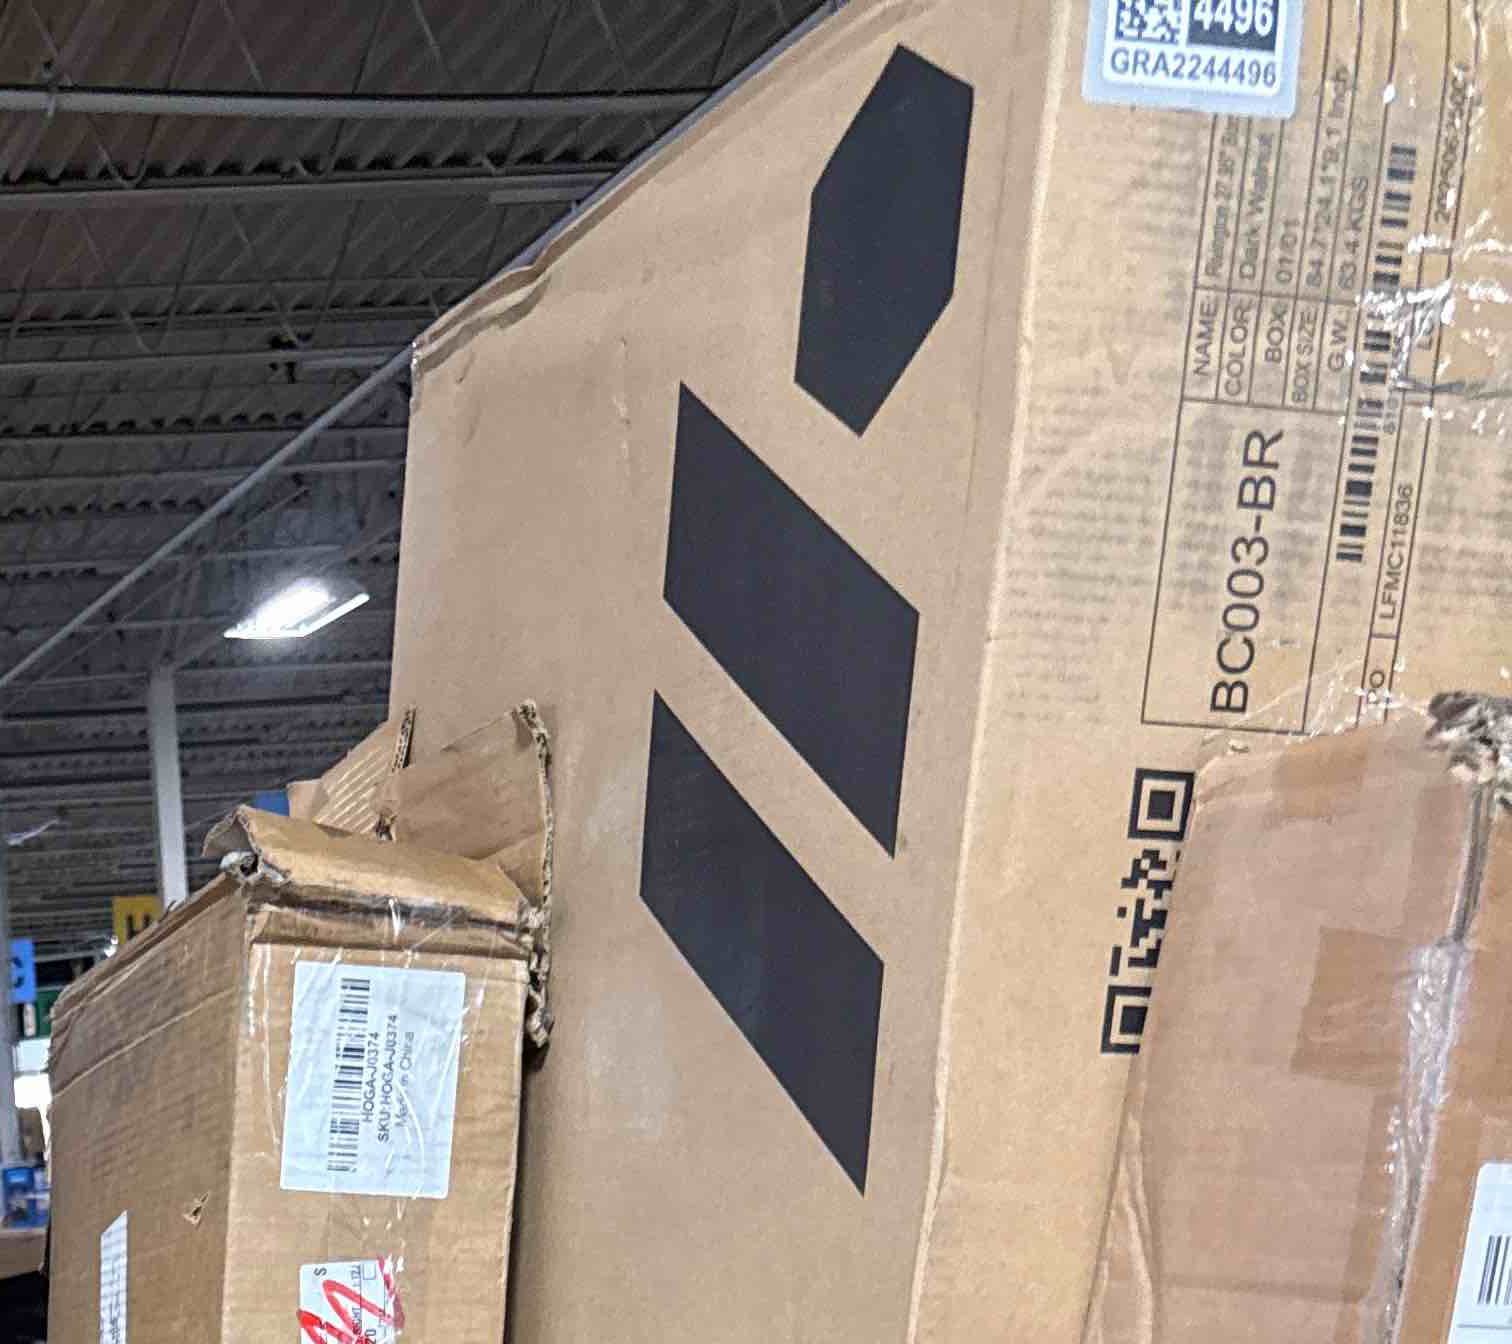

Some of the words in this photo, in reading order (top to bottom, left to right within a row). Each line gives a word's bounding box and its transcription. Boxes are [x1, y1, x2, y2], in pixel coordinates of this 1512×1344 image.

[1109, 45, 1278, 89] GRA2244496
[1192, 298, 1218, 375] NAME:
[1289, 359, 1312, 403] BOX
[1208, 427, 1284, 715] BC003-BR
[1377, 483, 1415, 619] LFMC11836
[398, 1030, 414, 1071] China
